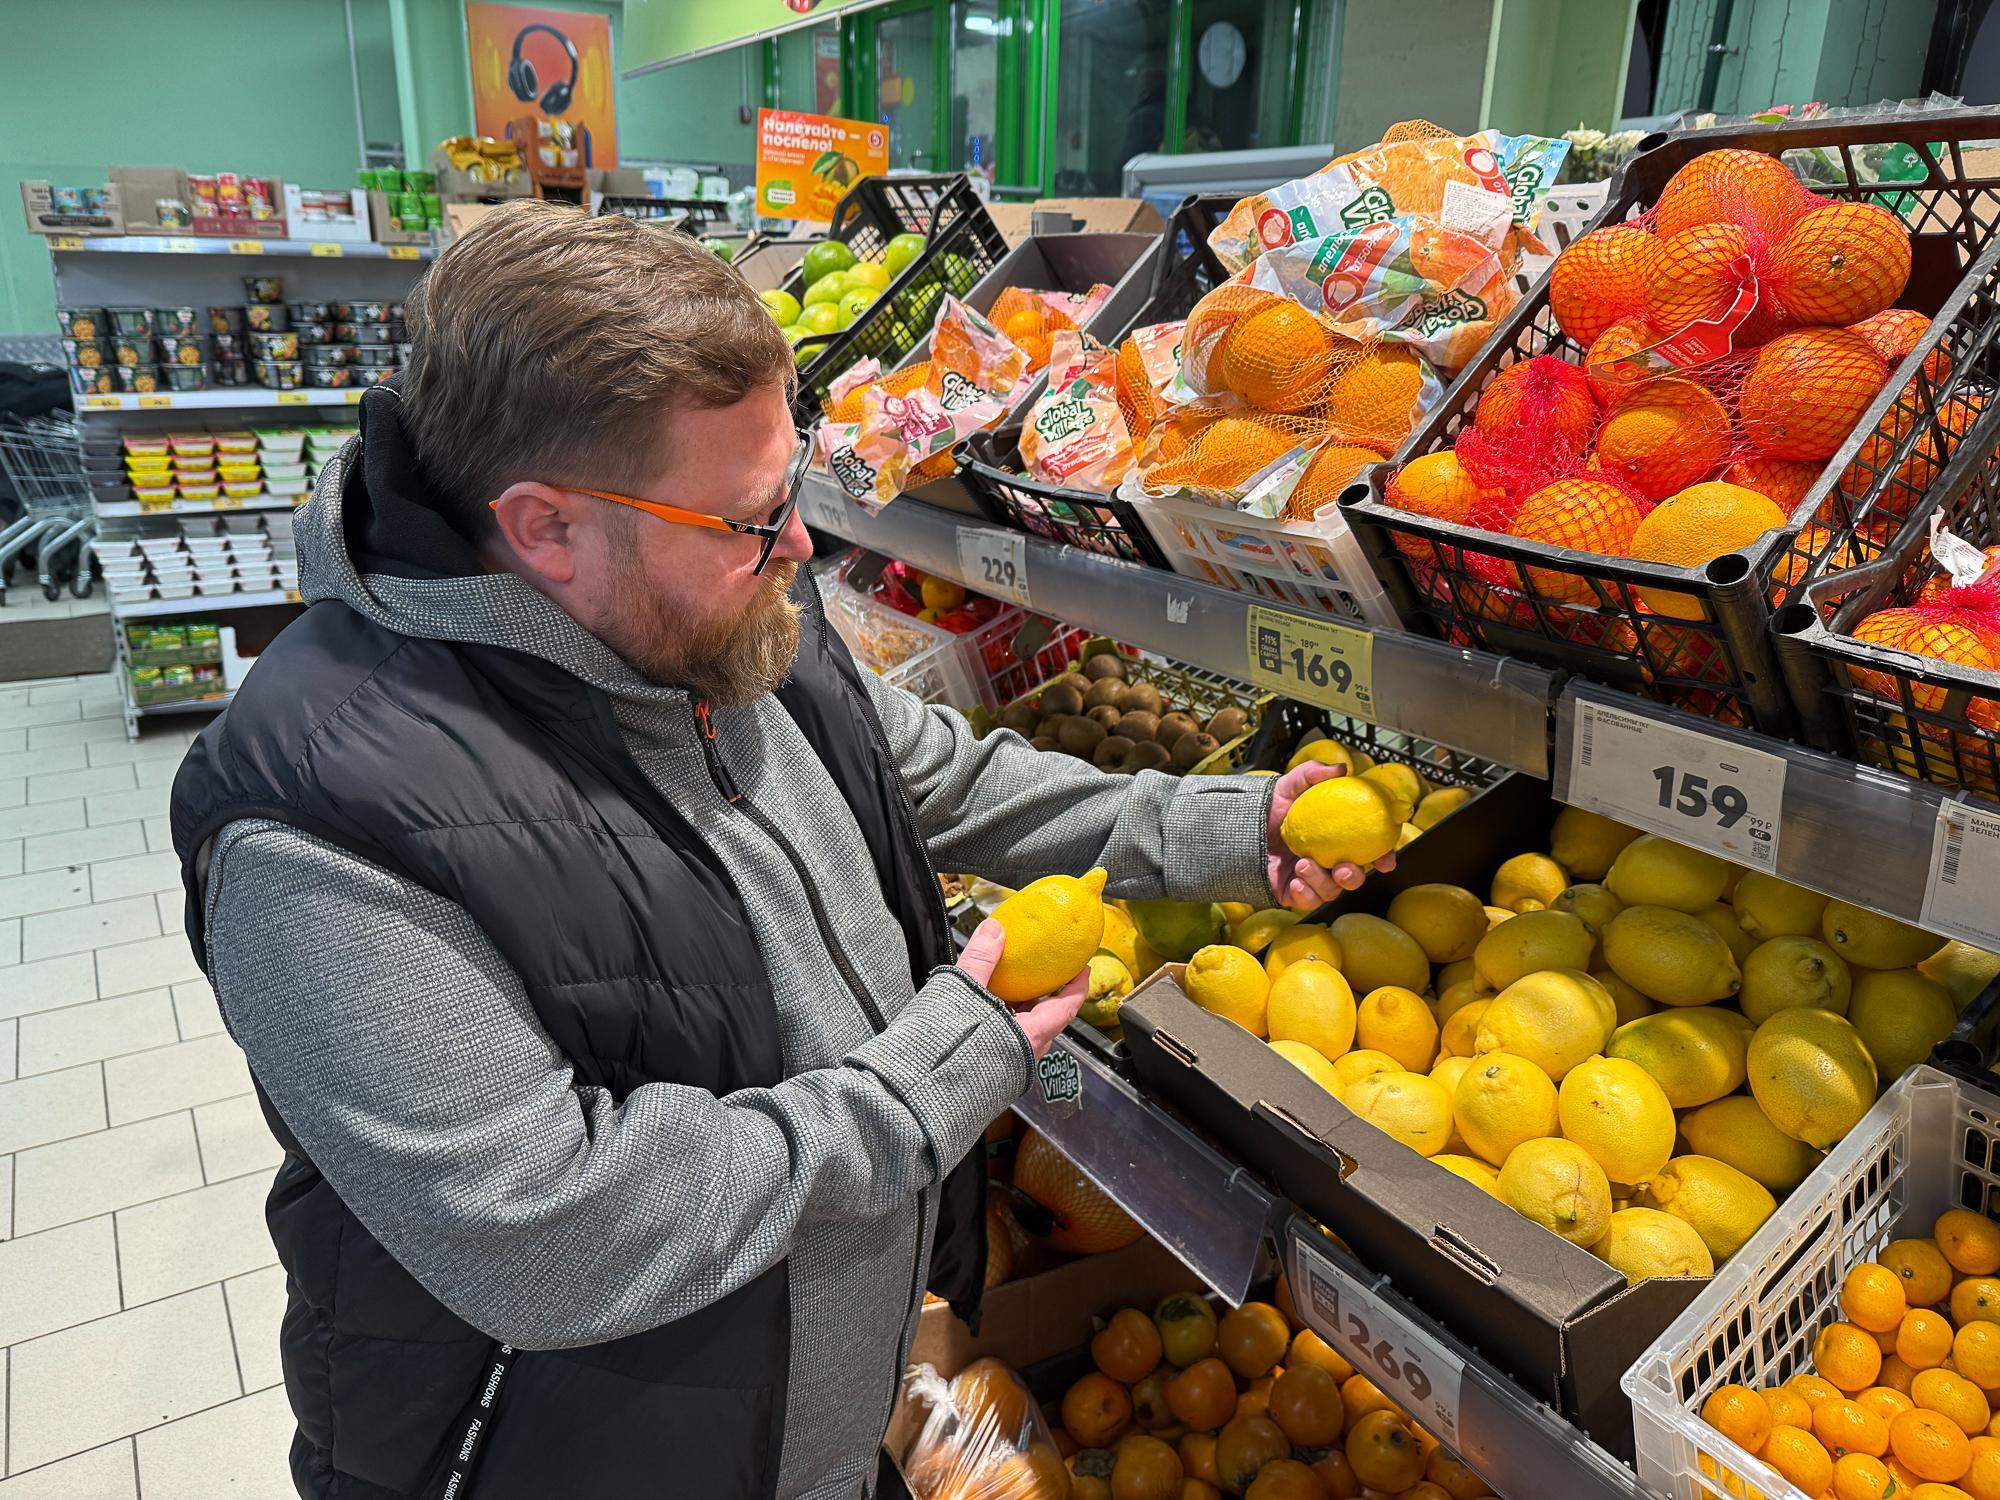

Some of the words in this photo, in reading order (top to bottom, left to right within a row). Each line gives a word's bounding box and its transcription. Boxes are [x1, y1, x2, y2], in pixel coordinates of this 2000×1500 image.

[763, 133, 833, 152] поспело!
[1036, 402, 1092, 431] Global
[981, 555, 1017, 587] 229
[1262, 634, 1277, 646] -11%
[1290, 647, 1353, 694] 169
[1597, 717, 1643, 734] ФАСОВАННЫЕ
[1652, 765, 1748, 829] 159
[1750, 817, 1764, 828] 99
[1039, 1054, 1070, 1079] Global
[1043, 1076, 1078, 1098] Village
[1348, 1312, 1432, 1402] 269
[480, 1363, 505, 1408] FASHIONS
[459, 1418, 482, 1462] FASHIONS
[443, 1470, 462, 1500] FASHIO
